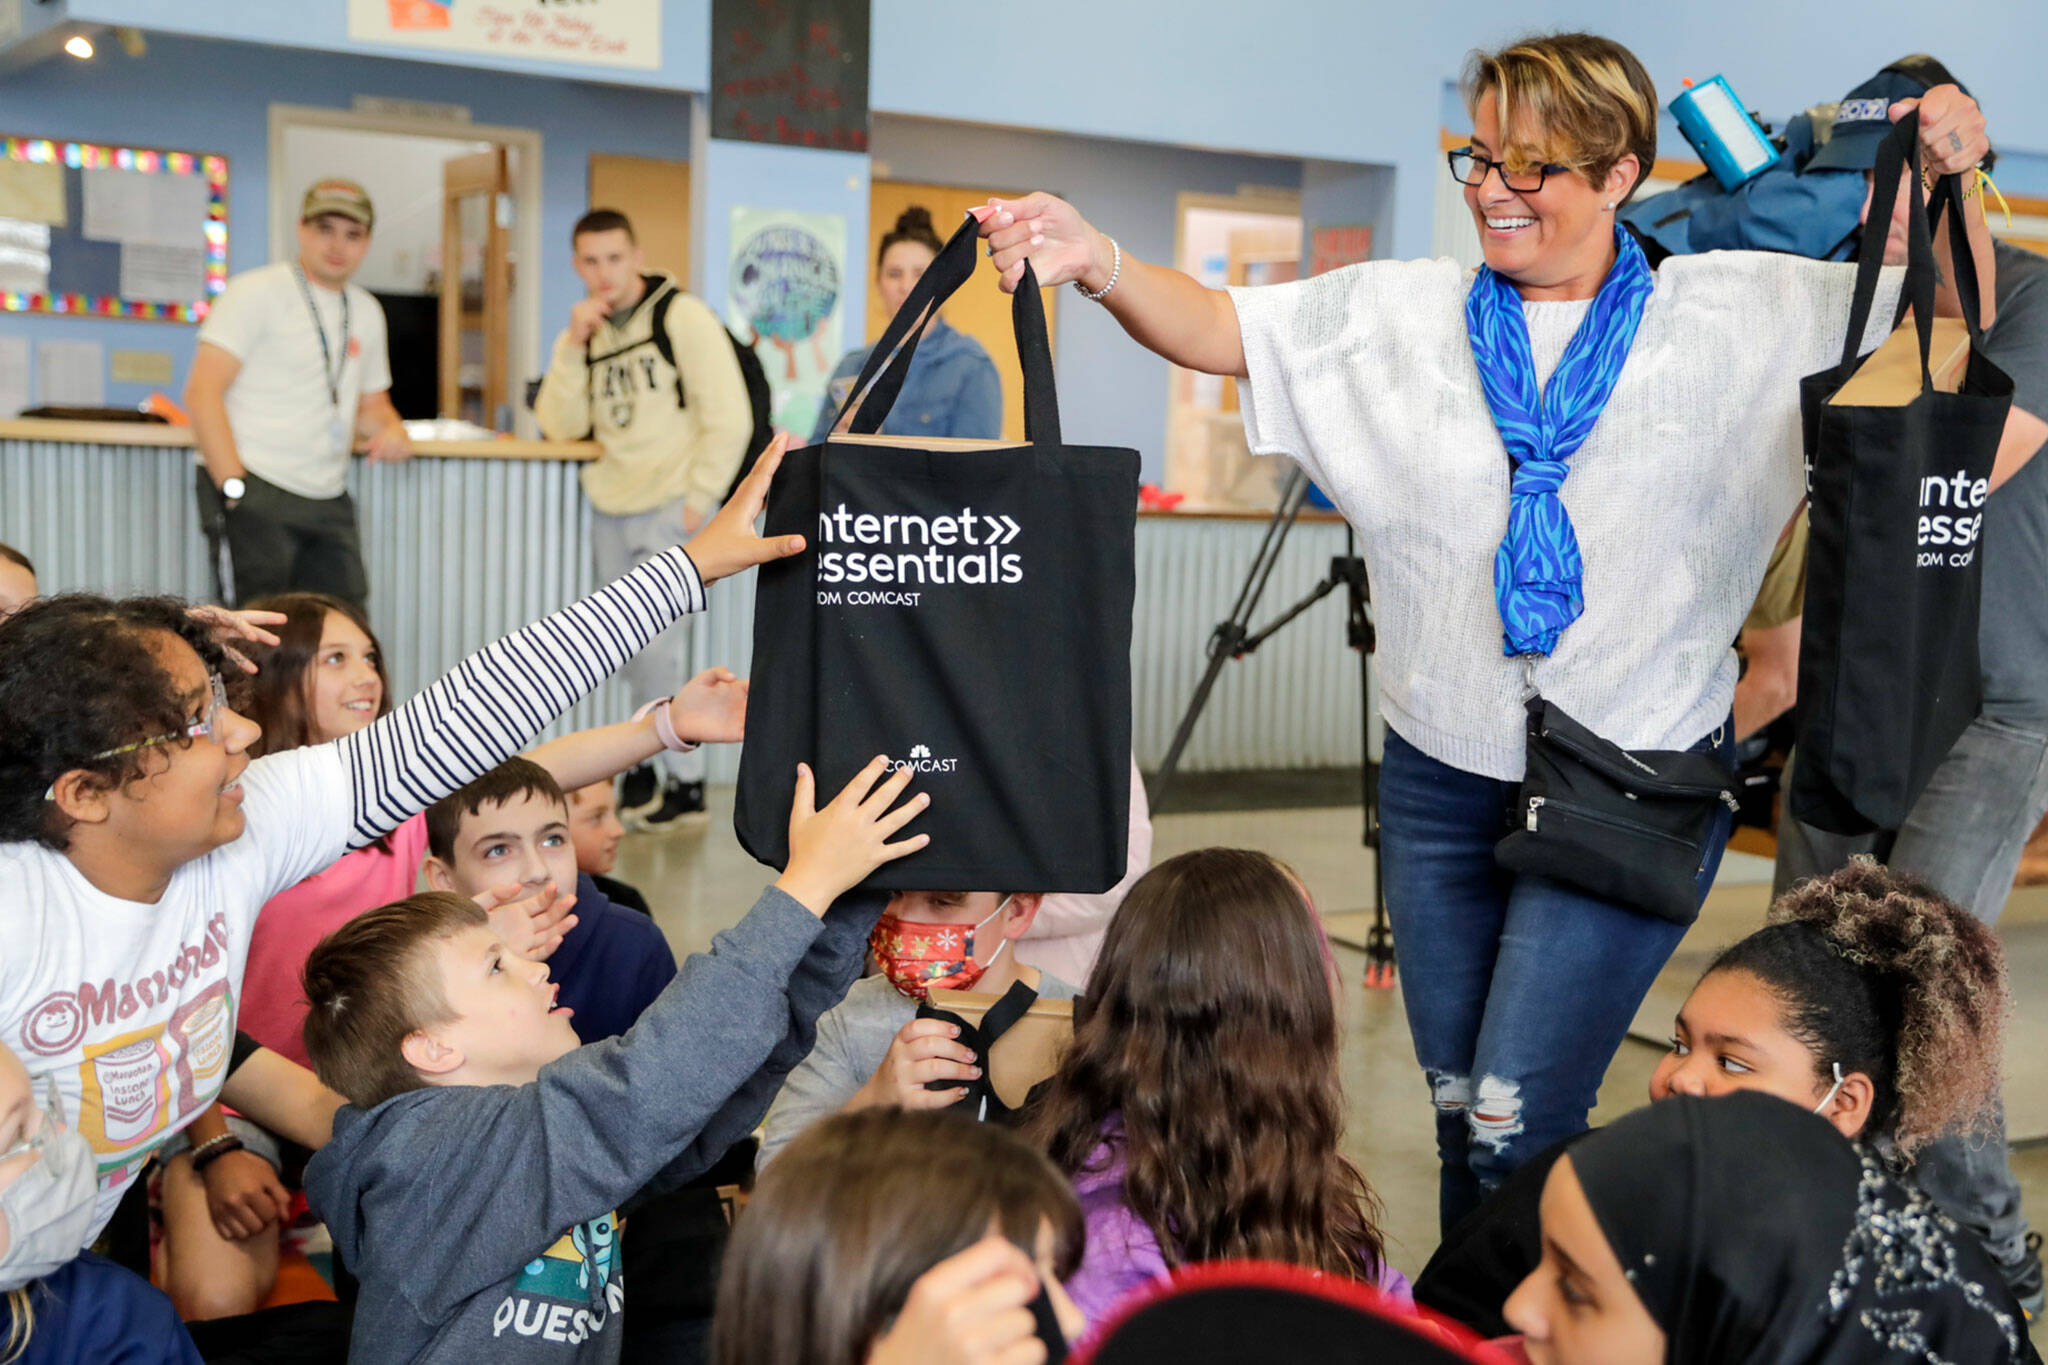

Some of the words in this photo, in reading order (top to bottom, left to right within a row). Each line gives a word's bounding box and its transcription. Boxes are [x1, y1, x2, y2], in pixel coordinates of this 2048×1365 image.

[817, 591, 842, 605] OM
[847, 591, 920, 606] COMCAST
[885, 759, 958, 773] COMCAST
